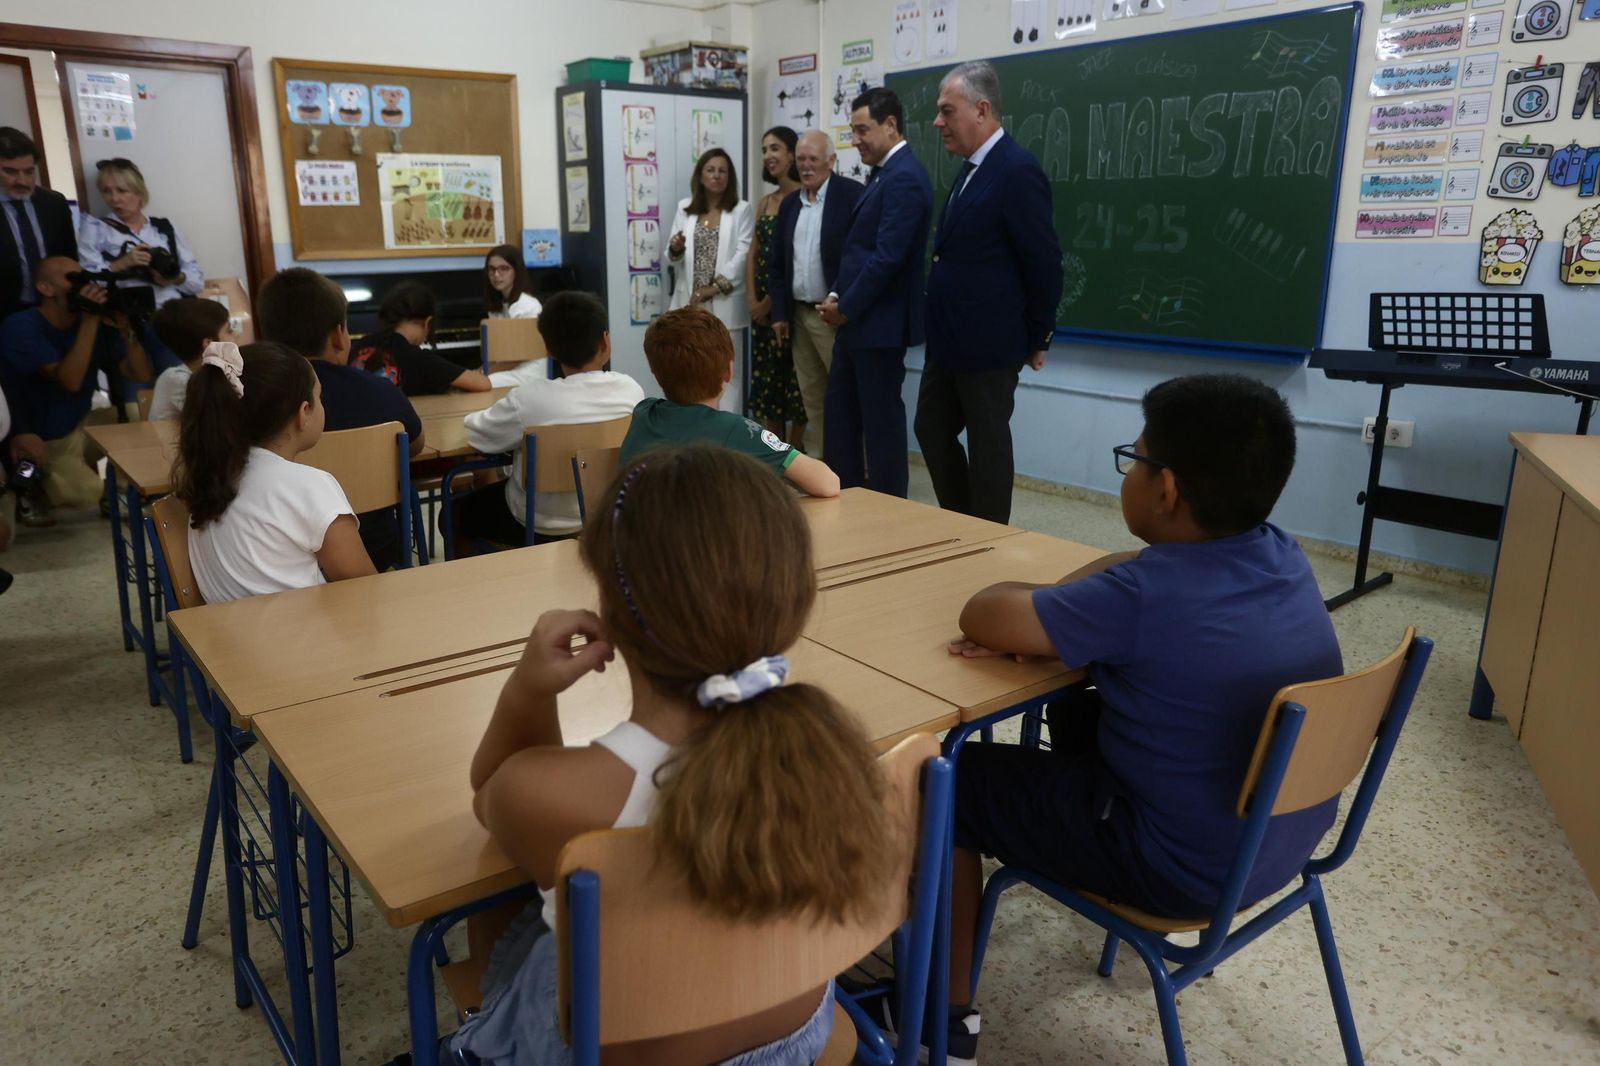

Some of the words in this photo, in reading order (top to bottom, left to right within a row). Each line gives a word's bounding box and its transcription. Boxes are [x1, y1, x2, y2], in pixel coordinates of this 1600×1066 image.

[1087, 76, 1343, 179] MAESTRA
[1072, 203, 1190, 253] 24-25
[1543, 368, 1590, 381] YAMAHA
